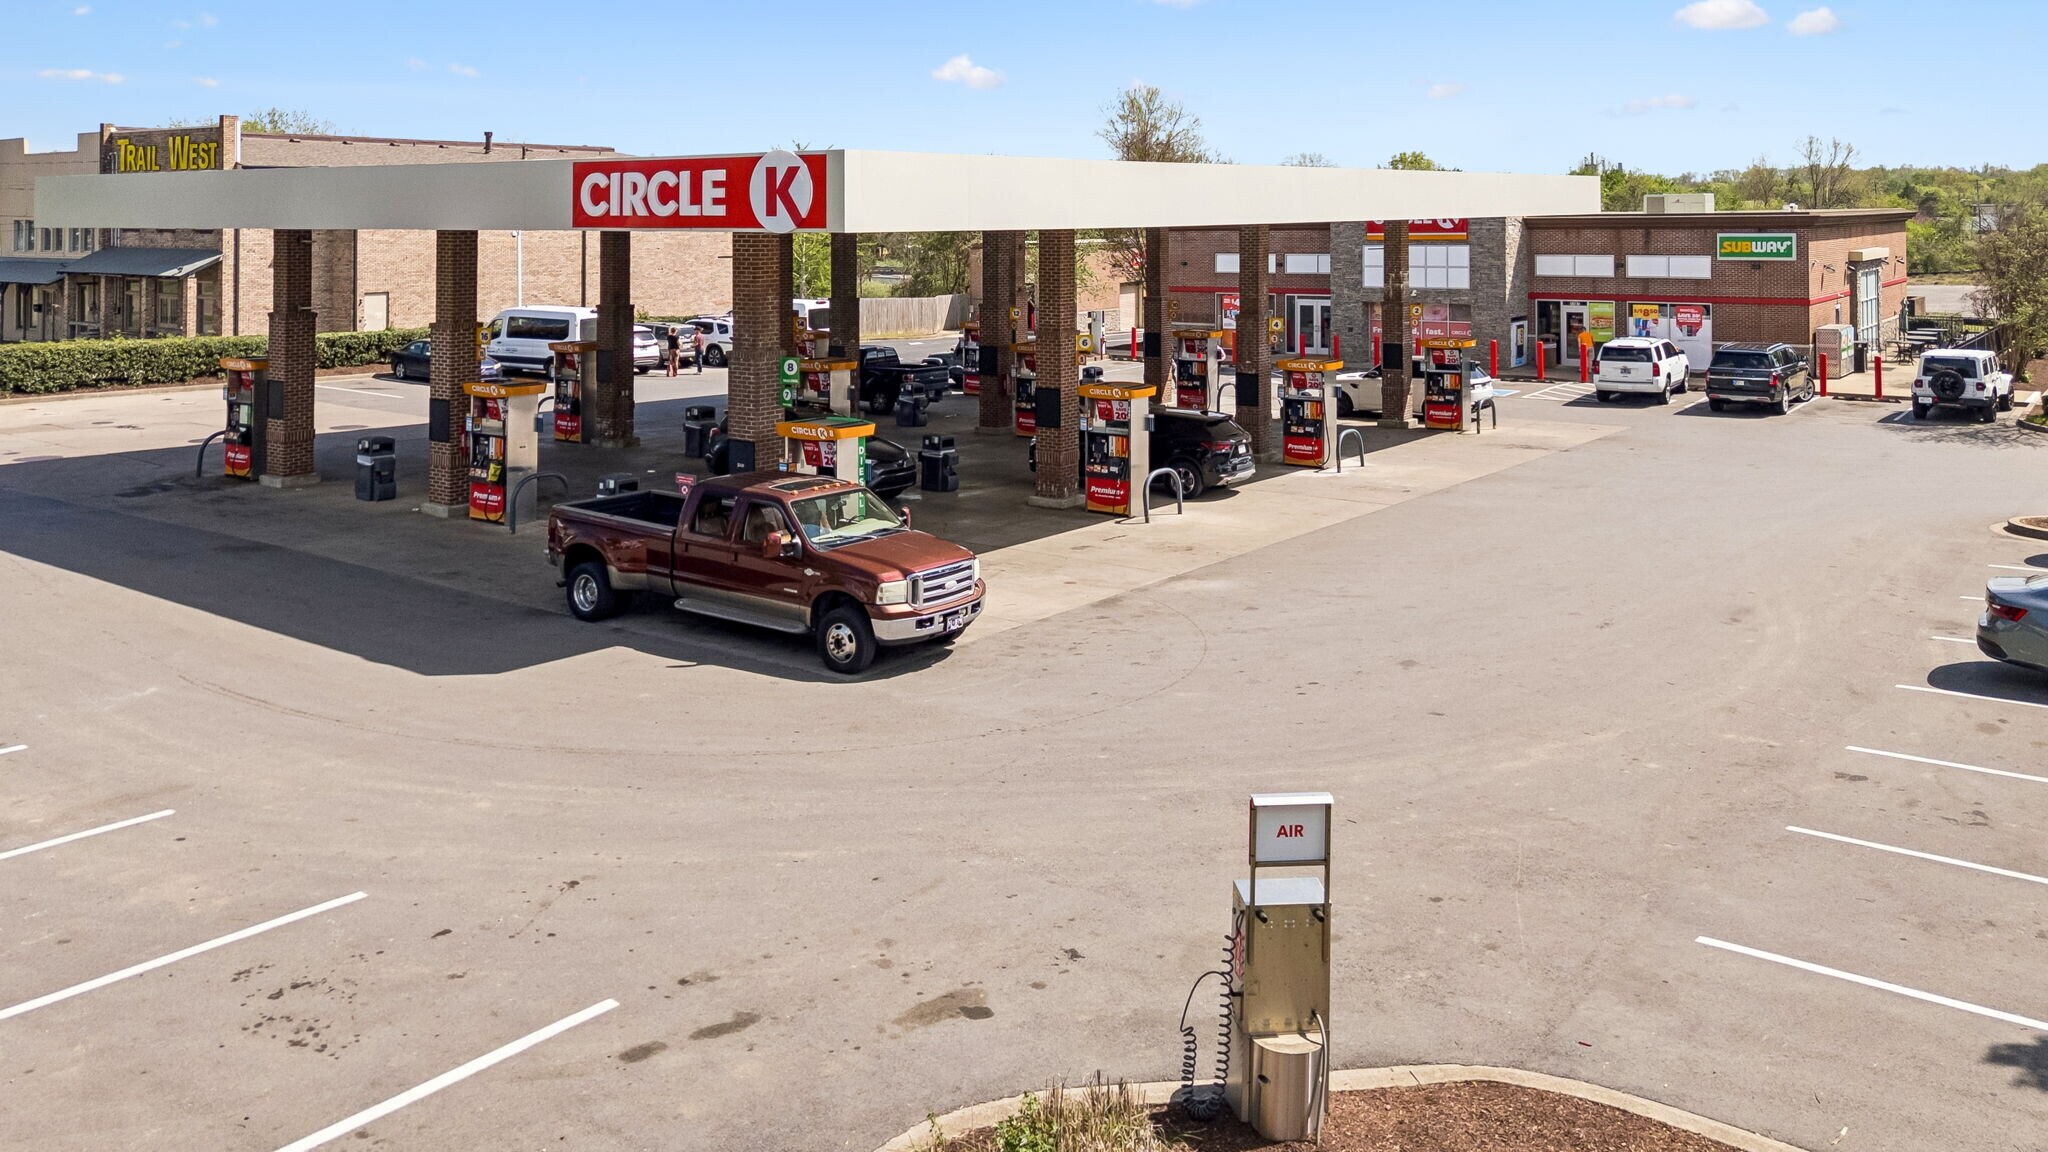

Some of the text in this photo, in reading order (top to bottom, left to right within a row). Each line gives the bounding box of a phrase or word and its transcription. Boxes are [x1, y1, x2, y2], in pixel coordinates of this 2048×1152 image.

[580, 163, 809, 230] CIRCLE K
[1721, 241, 1792, 253] SUBWAY
[481, 332, 488, 340] 16
[787, 362, 794, 372] 8
[1089, 388, 1111, 396] CIRCLE
[791, 427, 817, 436] CIRCLE
[1276, 824, 1304, 838] AIR
